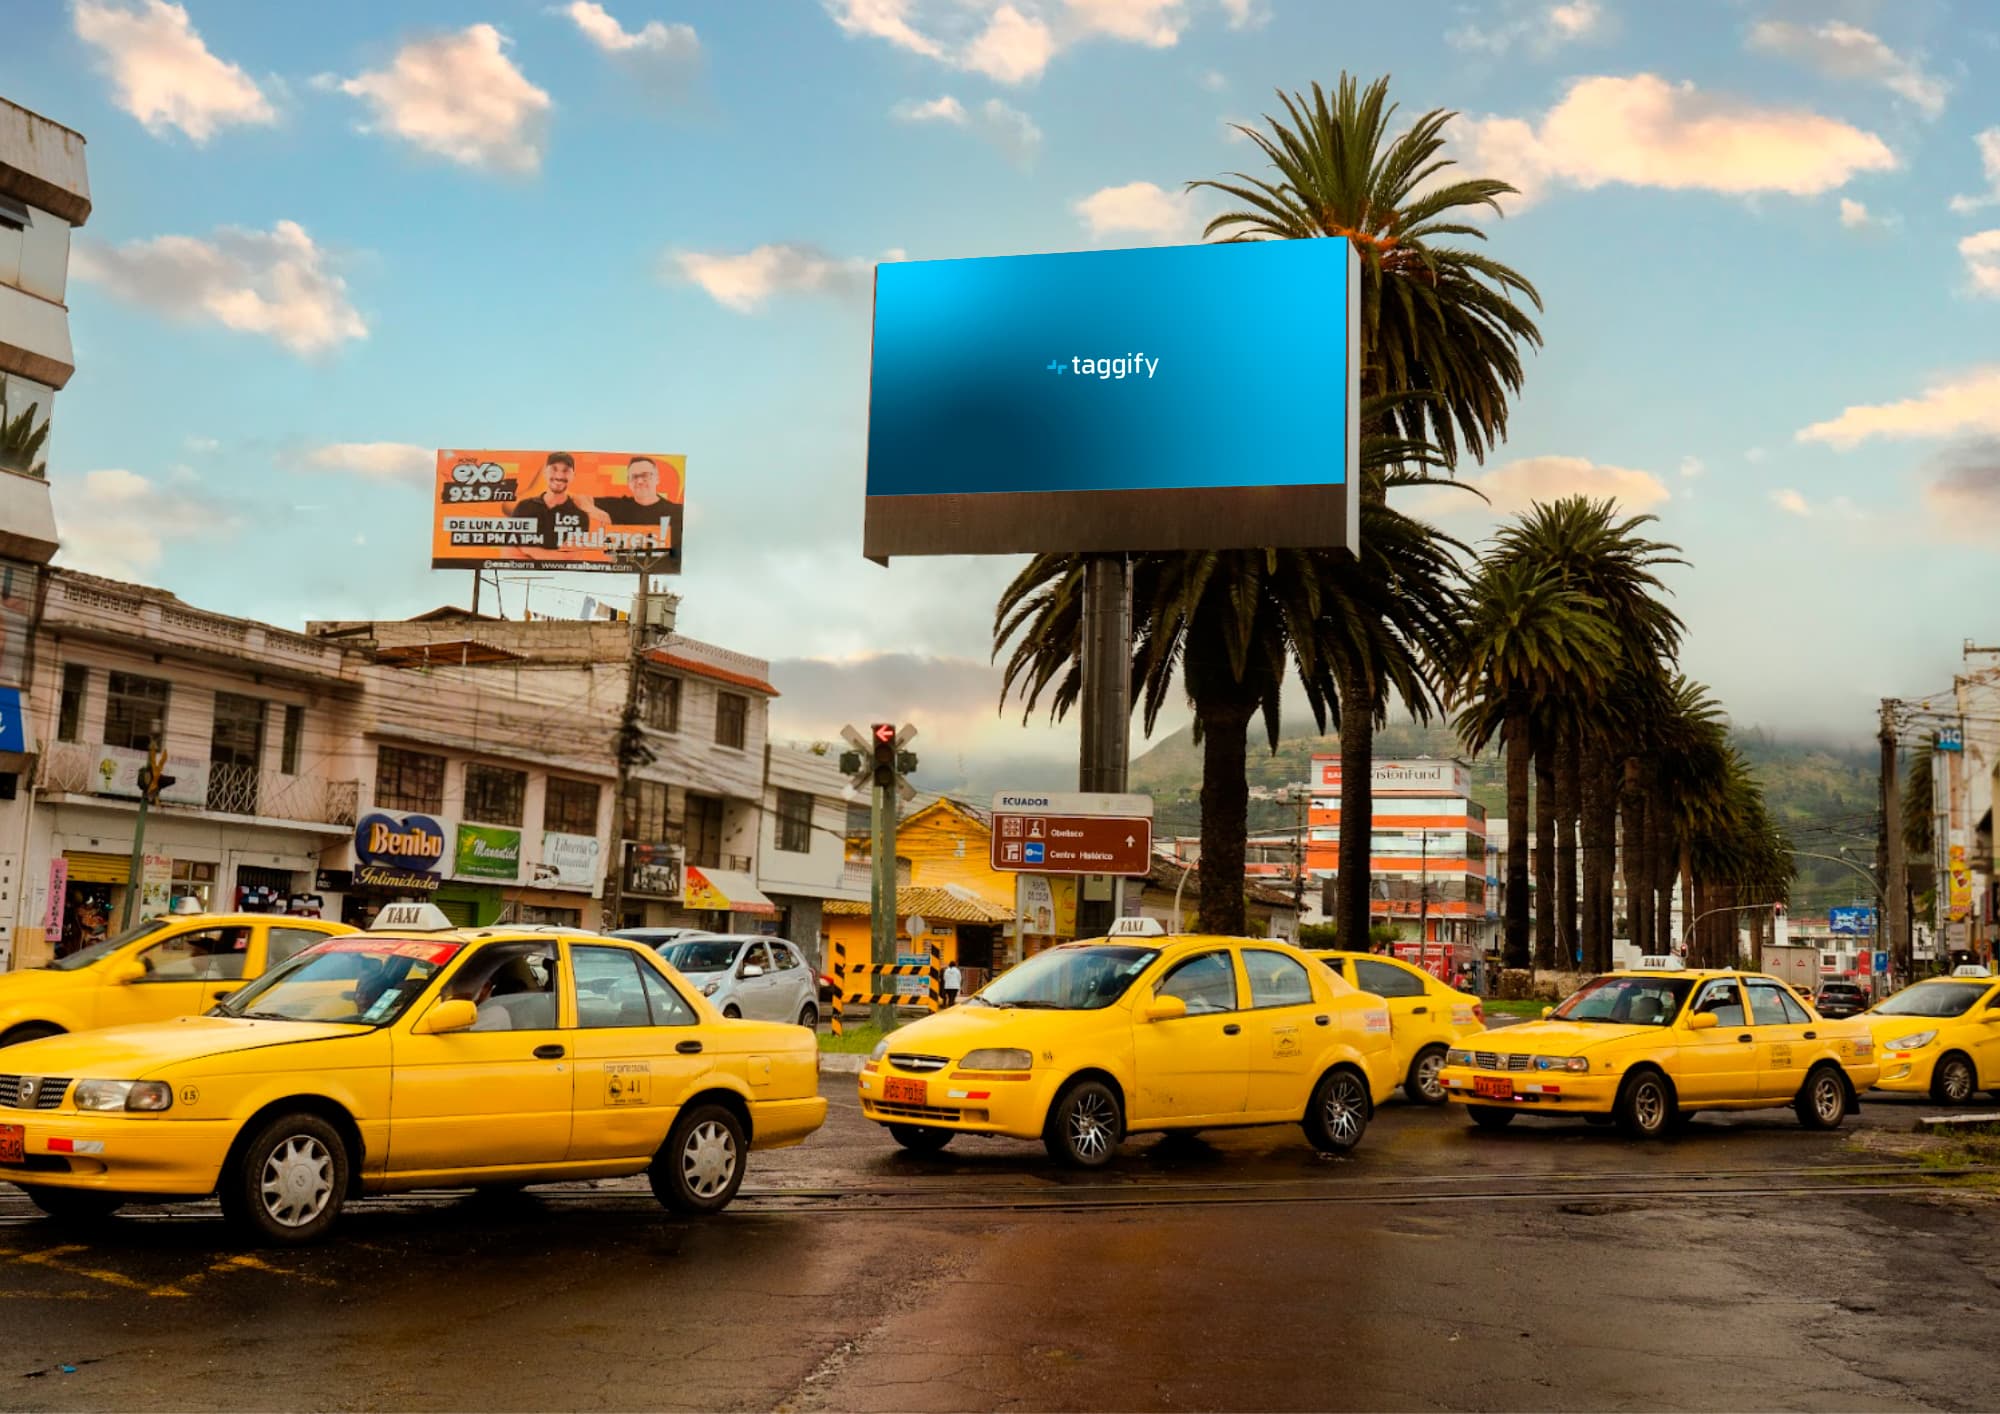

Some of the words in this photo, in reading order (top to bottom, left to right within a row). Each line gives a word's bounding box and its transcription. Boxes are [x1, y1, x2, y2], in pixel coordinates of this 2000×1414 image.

[1071, 352, 1159, 379] taggify
[453, 463, 504, 486] exa
[449, 486, 491, 502] 93.9
[493, 488, 513, 501] fm
[449, 520, 465, 529] DE
[469, 520, 493, 530] LUN
[496, 521, 504, 530] A
[507, 521, 530, 530] JUE
[555, 512, 579, 525] Los
[452, 533, 470, 543] DE
[472, 533, 484, 543] 12
[486, 533, 505, 543] PM
[508, 534, 518, 544] A
[521, 534, 544, 544] 1PM
[1002, 797, 1049, 807] ECUADOR
[1050, 829, 1084, 838] Obelisco
[355, 866, 440, 890] Intimidades
[386, 907, 421, 924] TAXI
[1120, 920, 1144, 932] TAXI
